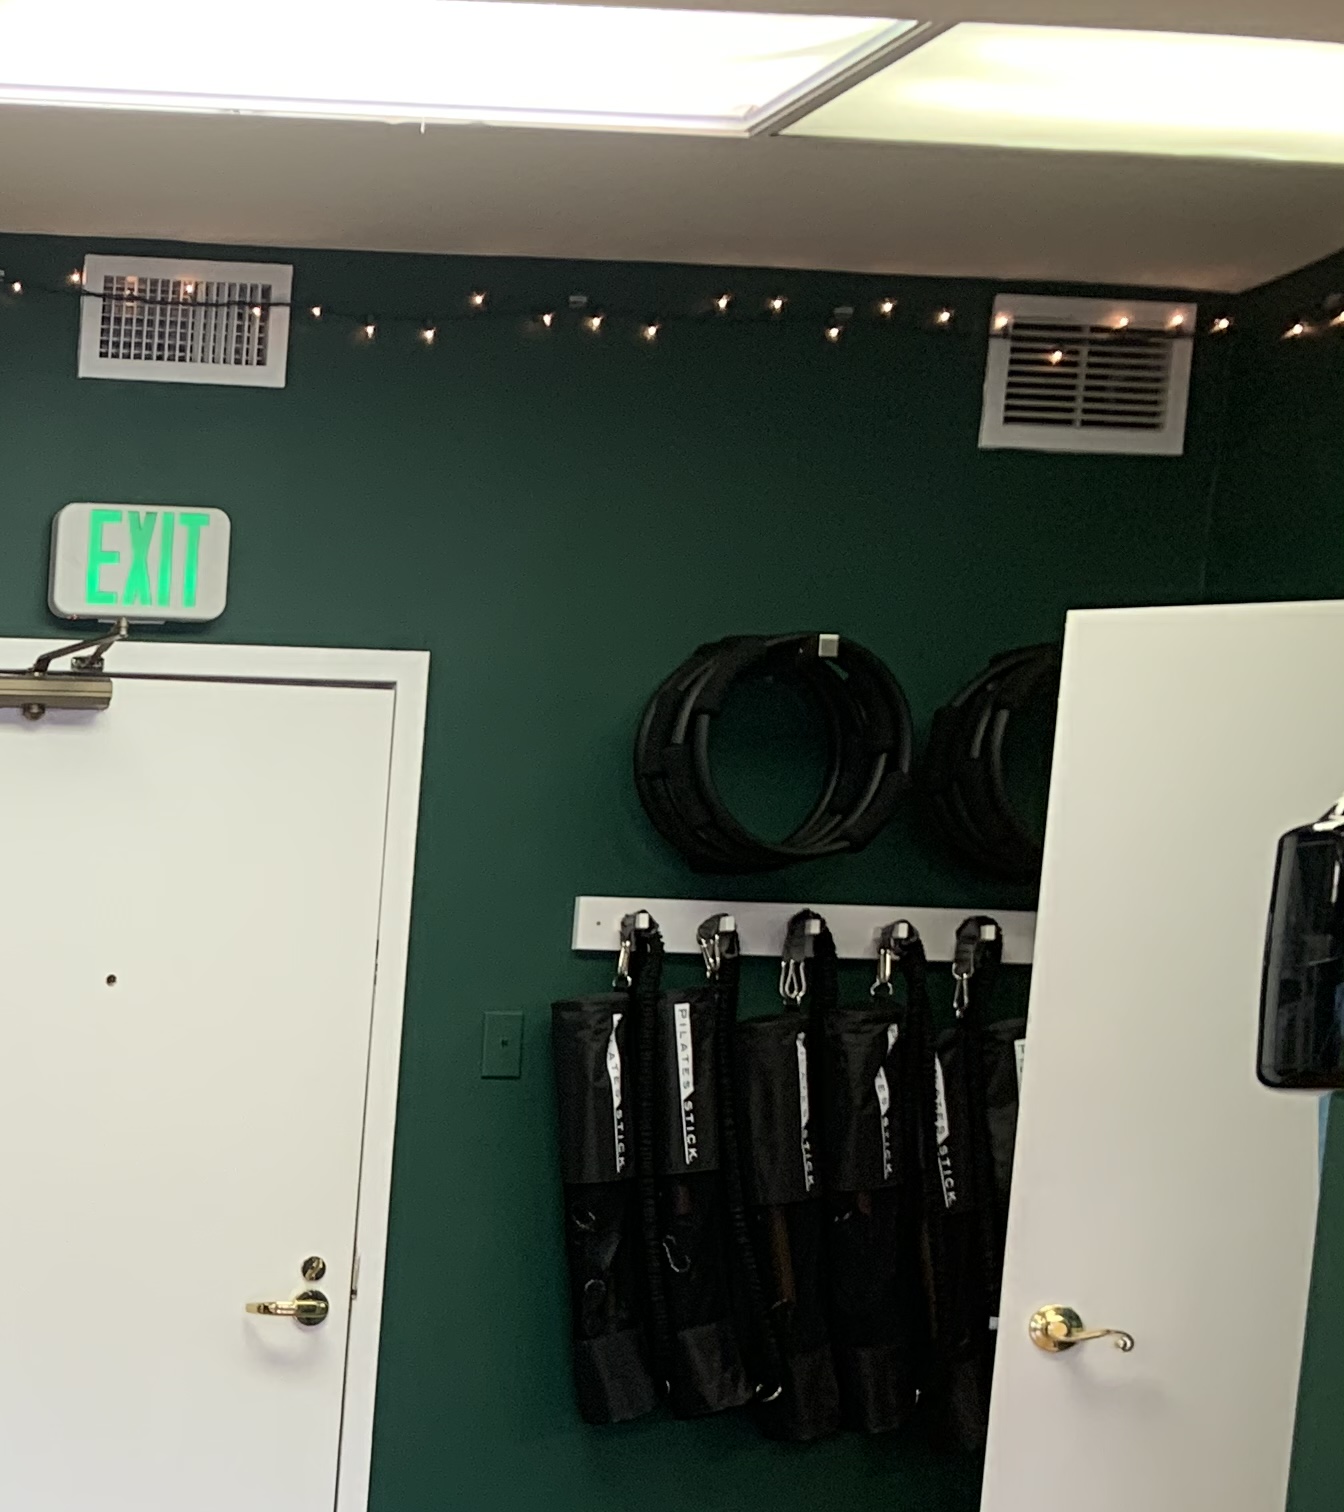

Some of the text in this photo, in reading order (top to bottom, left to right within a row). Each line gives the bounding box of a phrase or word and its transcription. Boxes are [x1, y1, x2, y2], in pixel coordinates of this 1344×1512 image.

[85, 508, 210, 609] EXIT
[678, 1008, 698, 1163] PILATES STICK
[615, 1109, 626, 1168] STICK
[938, 1144, 957, 1204] STICK
